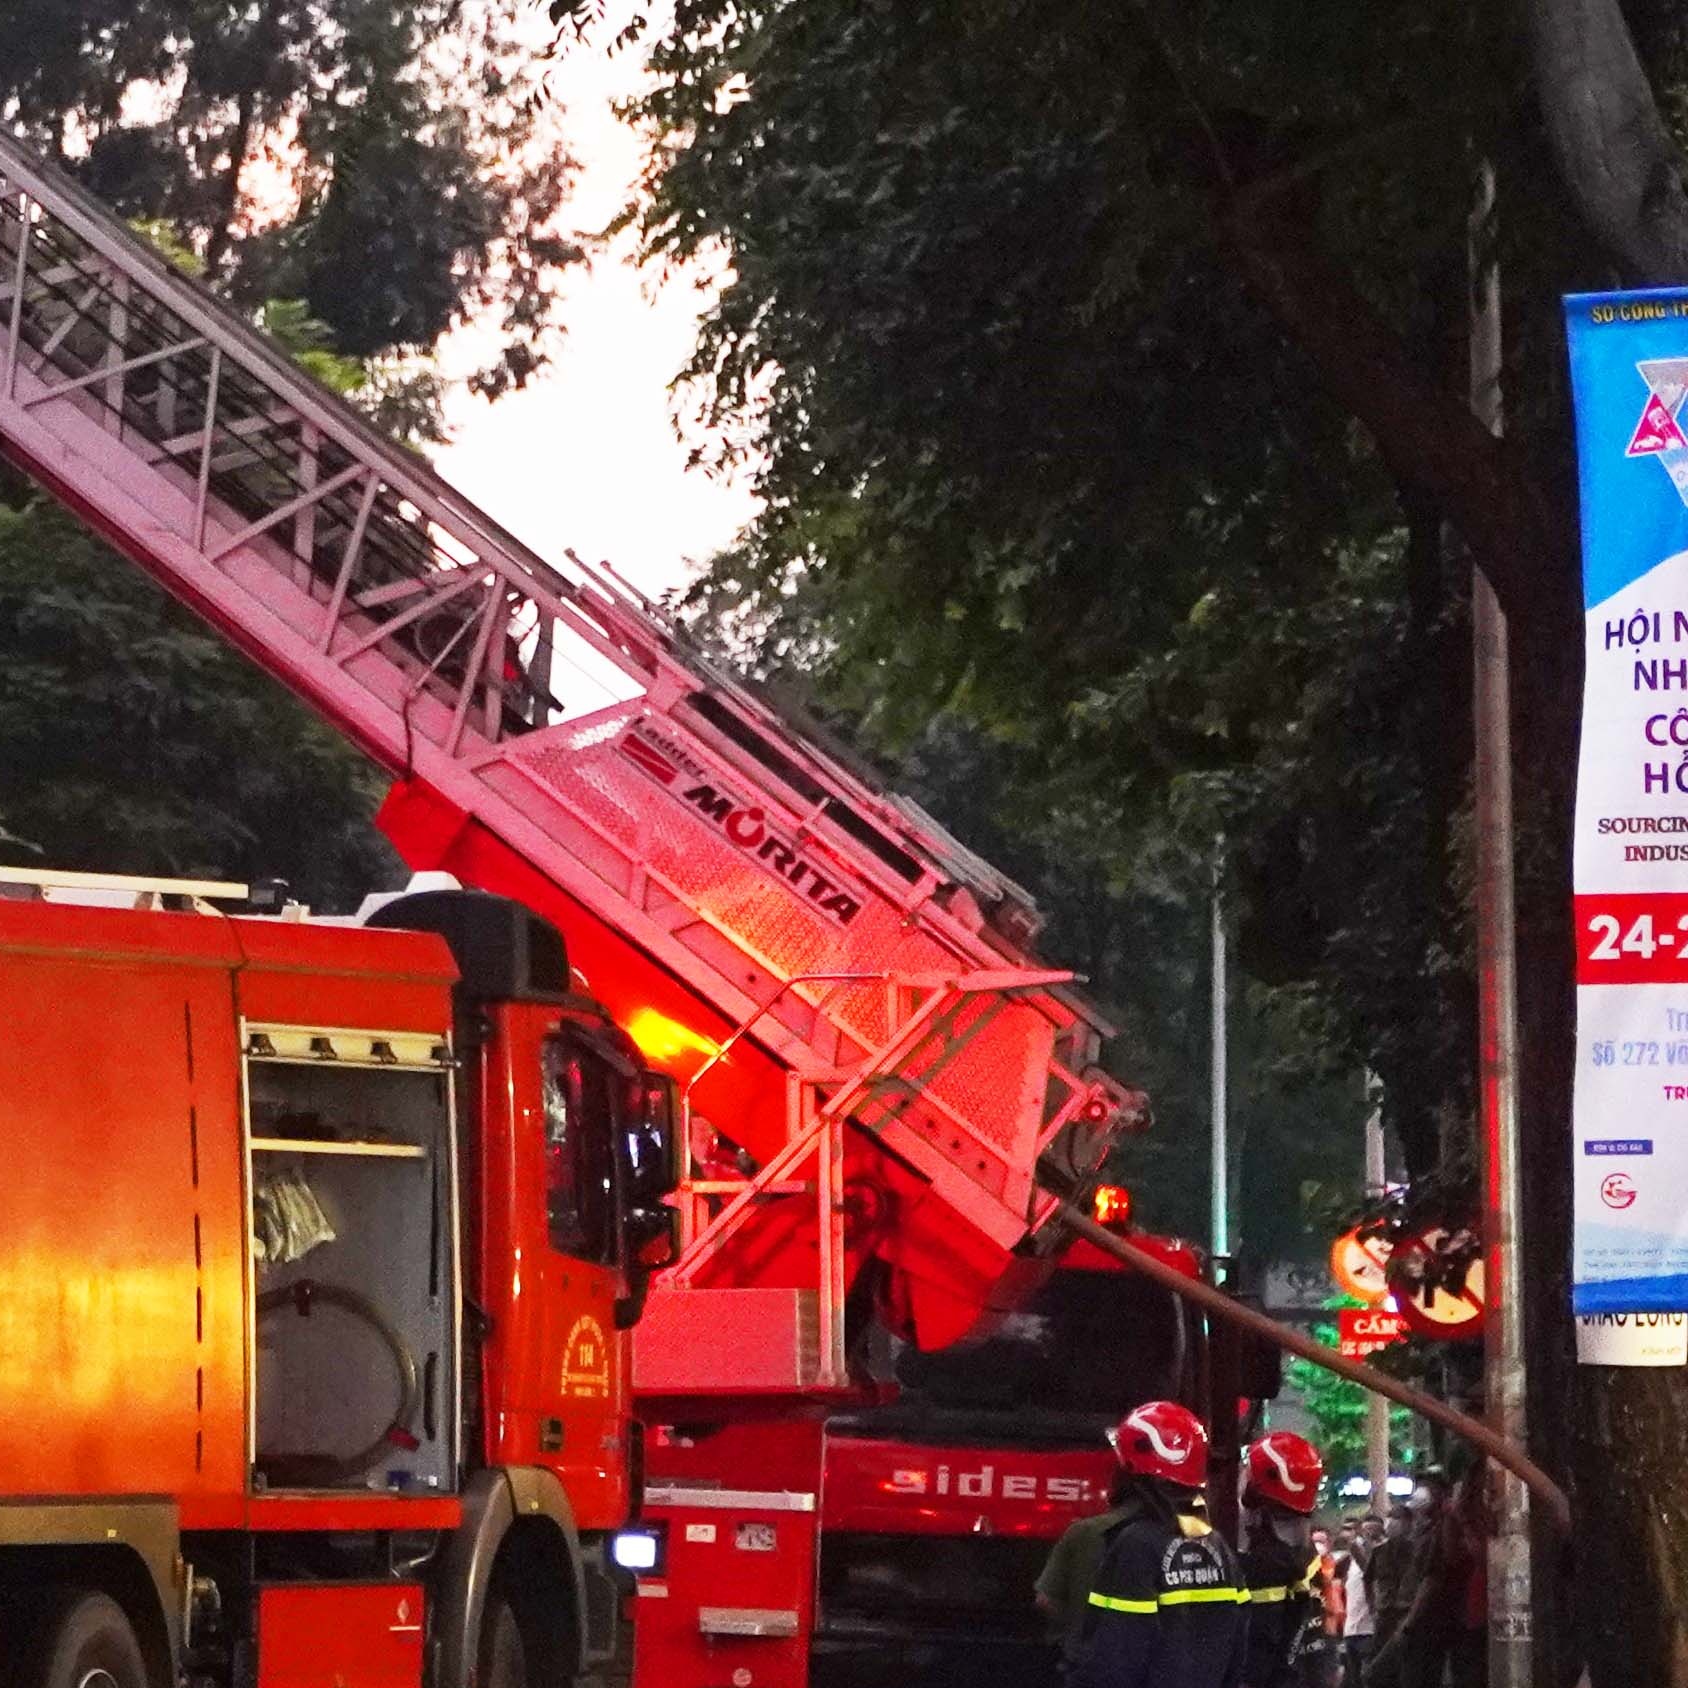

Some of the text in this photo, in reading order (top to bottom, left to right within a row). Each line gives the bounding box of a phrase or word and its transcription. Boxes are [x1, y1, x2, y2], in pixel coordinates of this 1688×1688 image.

[1605, 608, 1661, 653] HỘI
[683, 785, 861, 926] MORITA
[1623, 1040, 1660, 1066] 272
